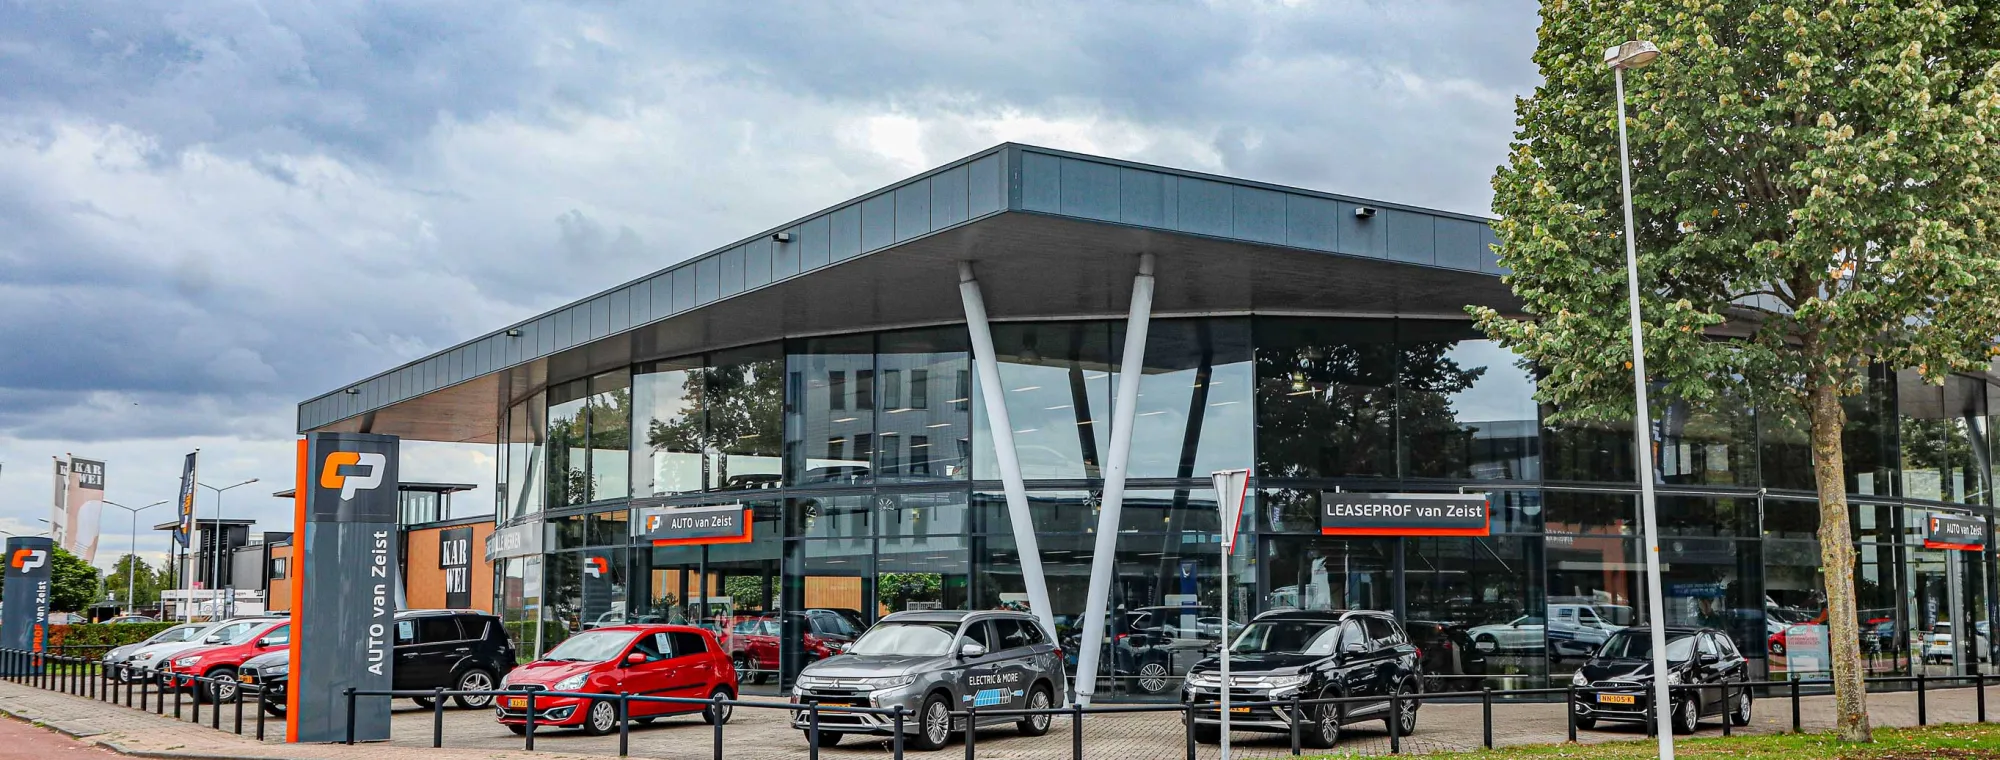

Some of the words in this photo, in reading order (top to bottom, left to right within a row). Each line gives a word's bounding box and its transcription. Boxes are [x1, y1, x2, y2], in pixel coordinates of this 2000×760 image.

[75, 462, 102, 475] KAR
[79, 473, 102, 485] WEI
[1326, 504, 1411, 517] LEASEPROF
[1416, 506, 1442, 517] van
[1446, 505, 1483, 518] Zeist
[671, 518, 692, 529] AUTO
[695, 519, 709, 528] van
[711, 515, 732, 527] Zeist
[1946, 522, 1960, 534] AUTO
[1961, 525, 1970, 535] van
[1970, 524, 1983, 536] Zeist
[371, 530, 388, 578] Zeist
[442, 539, 467, 566] KAR
[446, 567, 467, 593] WEI
[36, 580, 47, 604] Zeist
[373, 583, 386, 619] van
[36, 606, 45, 623] van
[368, 623, 384, 676] AUTO
[969, 675, 996, 685] ELECTRIC
[997, 675, 1002, 683] &
[1002, 673, 1018, 682] MORE
